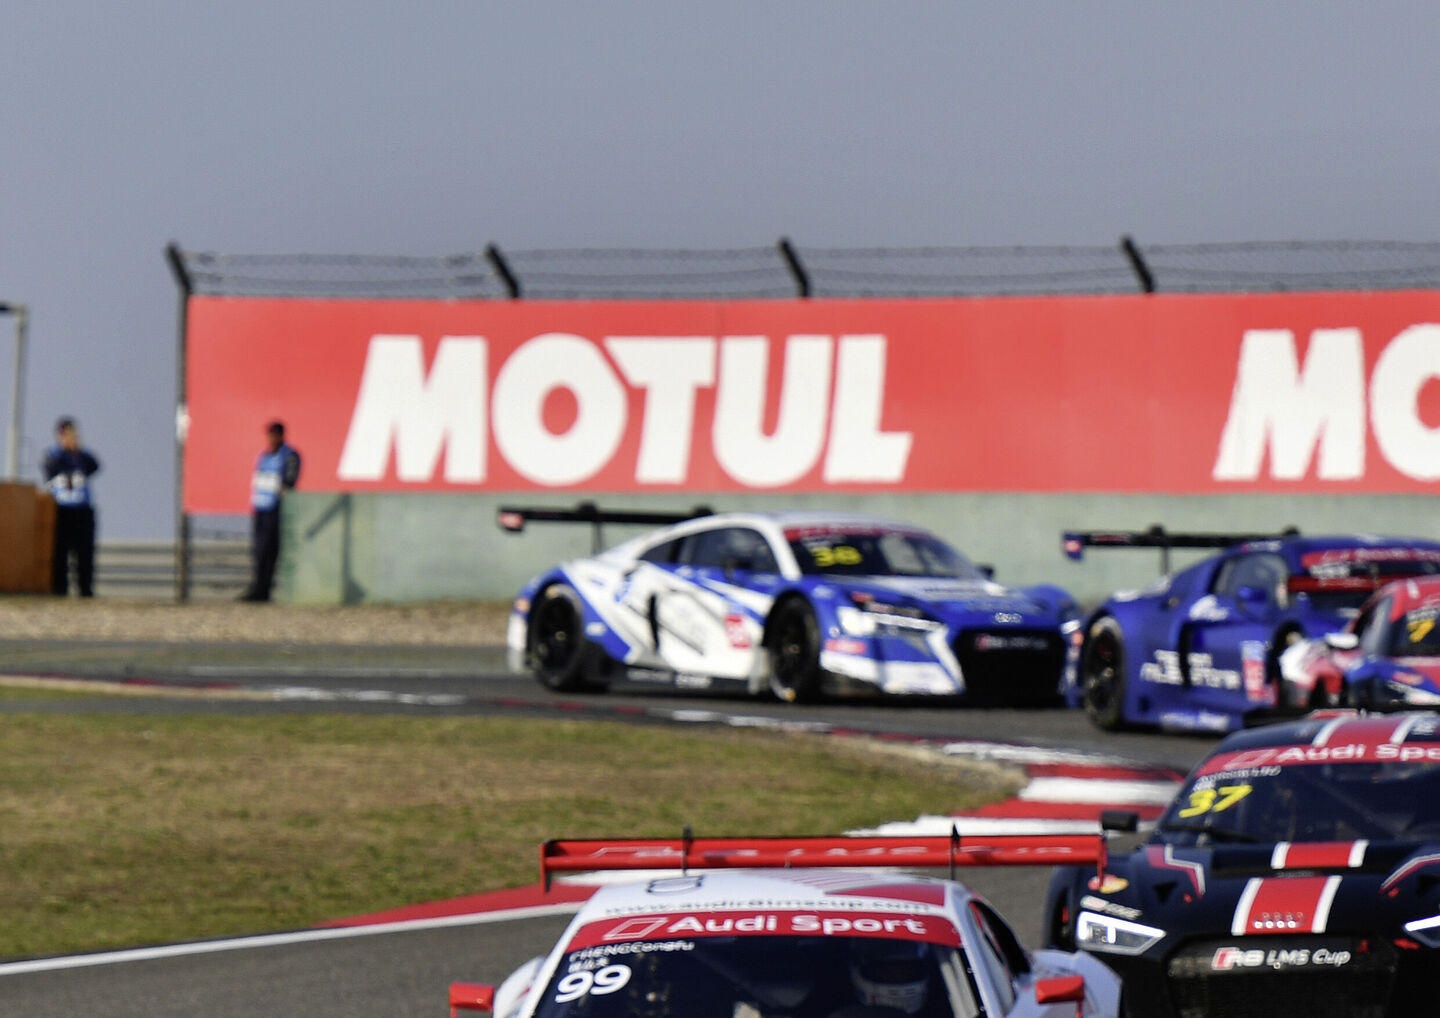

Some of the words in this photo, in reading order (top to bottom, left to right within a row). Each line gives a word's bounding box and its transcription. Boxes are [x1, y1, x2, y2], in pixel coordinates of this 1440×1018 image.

[338, 332, 913, 487] MOTUL
[1278, 744, 1366, 763] Audi
[1178, 785, 1254, 818] 37
[668, 914, 778, 933] Audi
[790, 914, 927, 935] Sport
[1266, 948, 1310, 967] LMS
[1311, 948, 1351, 968] Cup
[555, 964, 631, 1004] 99
